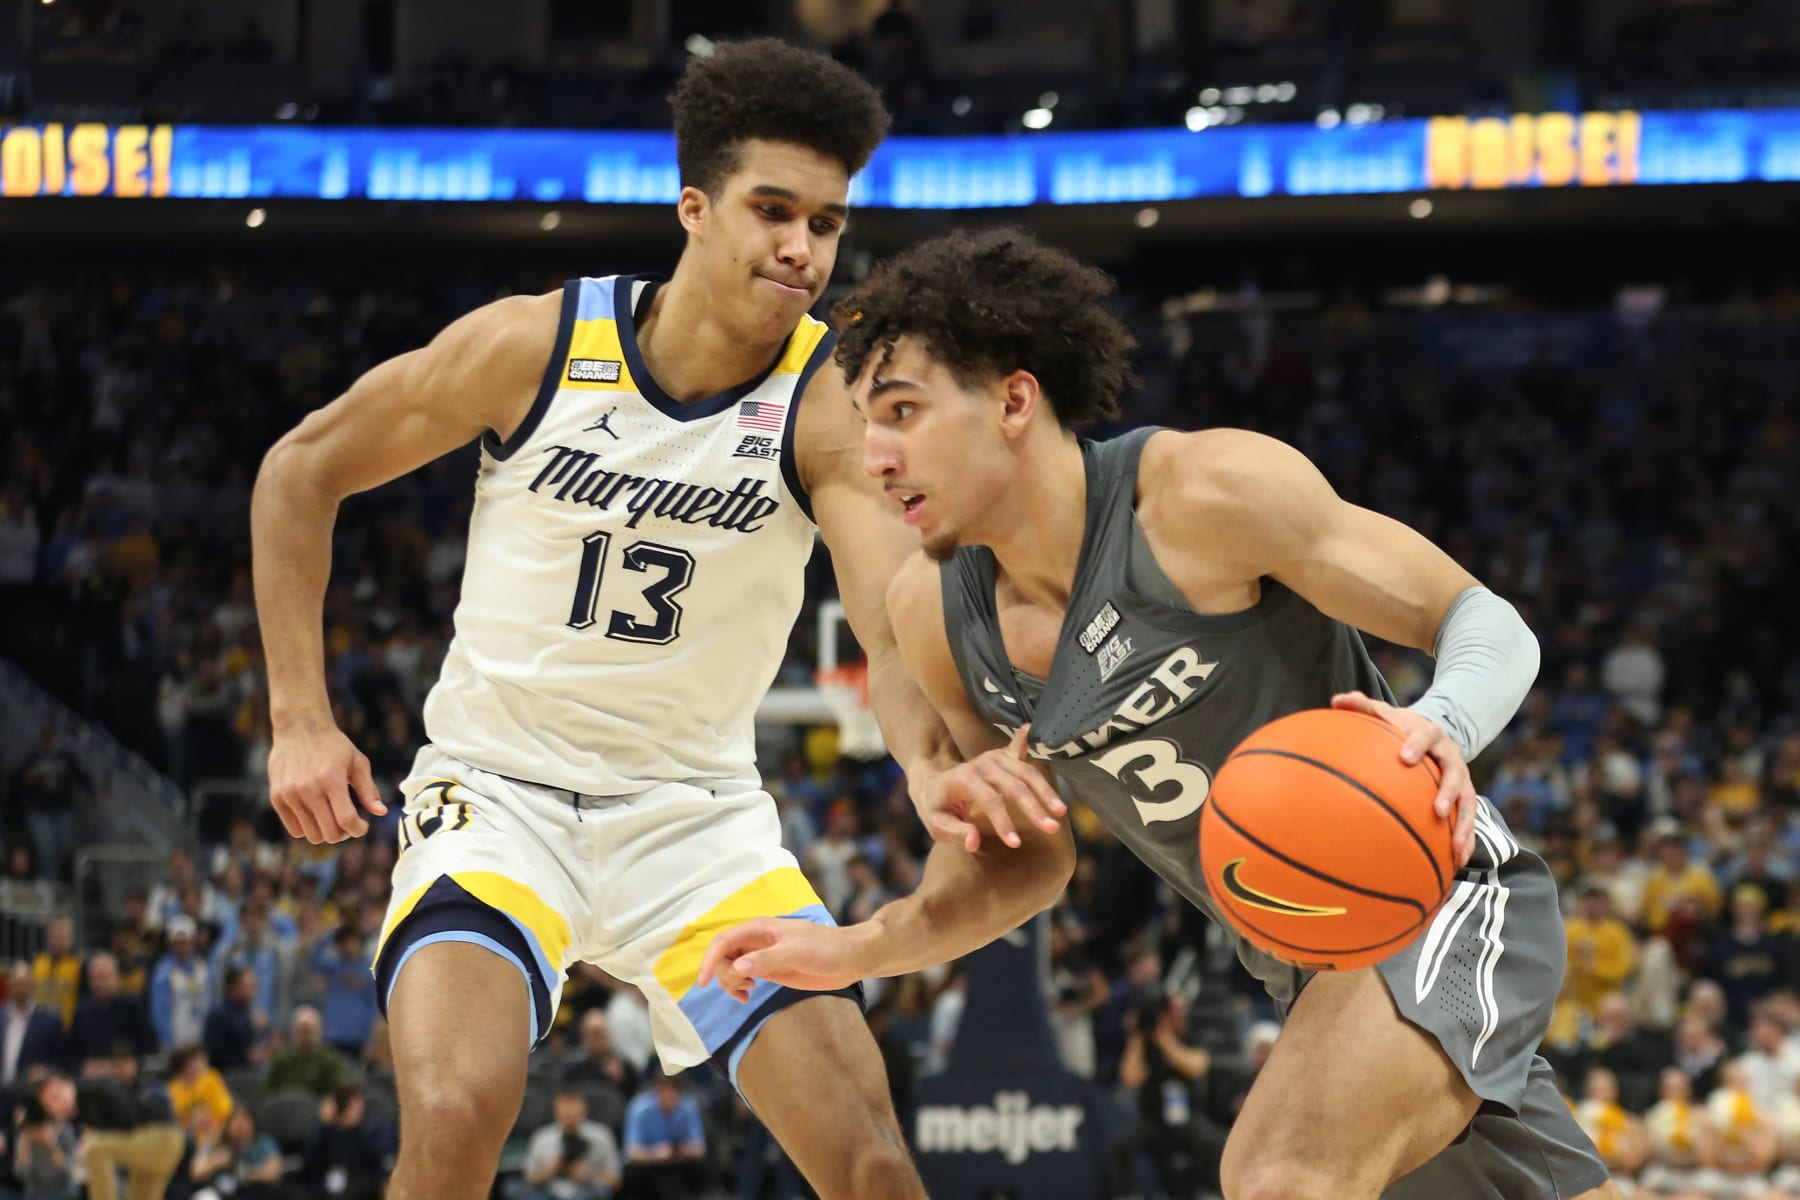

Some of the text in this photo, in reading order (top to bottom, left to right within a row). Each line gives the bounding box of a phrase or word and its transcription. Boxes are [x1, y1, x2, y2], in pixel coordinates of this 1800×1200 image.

[1428, 111, 1639, 190] NOISE!
[570, 370, 619, 381] CHANGE
[735, 444, 782, 457] EAST
[741, 435, 775, 447] BIG
[528, 444, 780, 533] Marquette
[566, 530, 696, 646] 13
[1097, 633, 1121, 667] BIG
[1100, 636, 1132, 678] EAST
[1089, 739, 1211, 828] 3
[916, 1090, 1085, 1165] meijer
